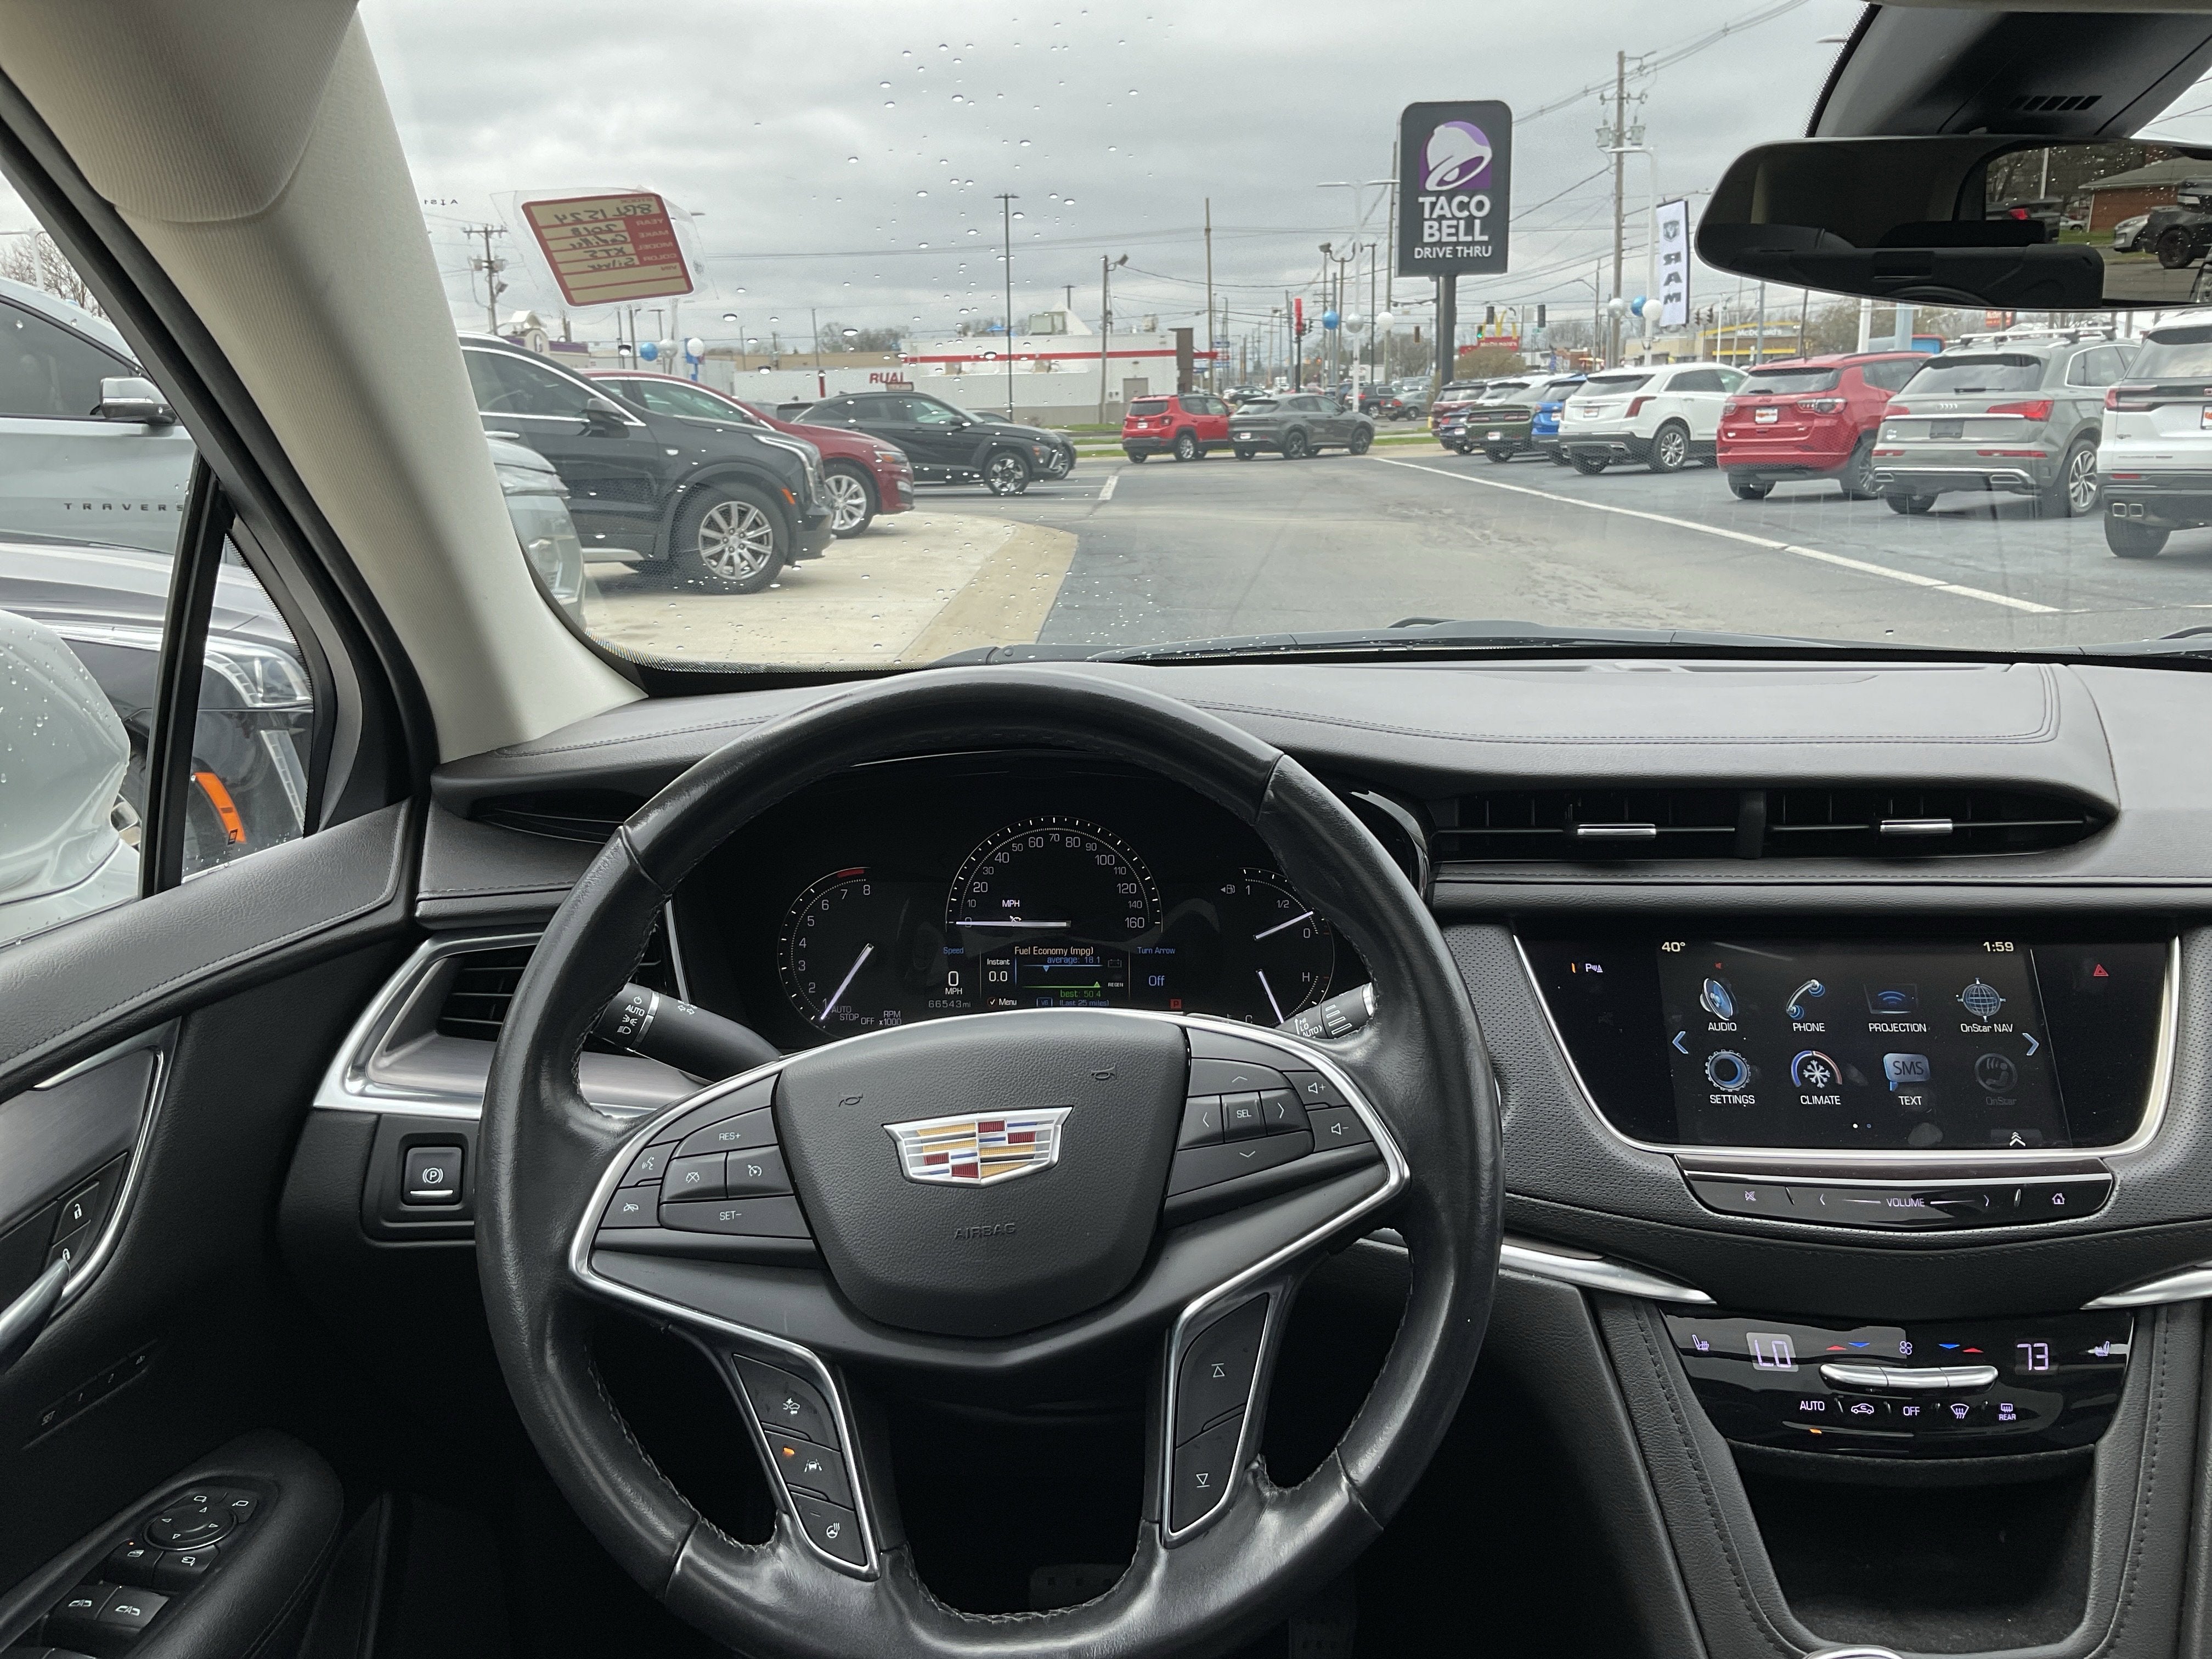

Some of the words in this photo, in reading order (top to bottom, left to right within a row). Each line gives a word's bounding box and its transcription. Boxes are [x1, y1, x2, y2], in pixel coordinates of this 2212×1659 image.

[1418, 195, 1491, 219] TACO
[1423, 219, 1489, 243] BELL
[1414, 247, 1453, 259] DRIVE
[1455, 245, 1492, 258] THRU
[1029, 837, 1043, 848] 60
[1049, 833, 1060, 842] 70
[1065, 837, 1080, 848] 80
[1012, 843, 1023, 851] 50
[1086, 843, 1097, 851] 90
[994, 853, 1009, 863] 40
[1094, 855, 1115, 865] 100
[983, 867, 994, 875] 30
[1114, 866, 1126, 875] 110
[863, 884, 871, 895] 8
[973, 882, 988, 893] 20
[1116, 883, 1137, 894] 120
[1245, 885, 1250, 895] 1
[840, 889, 848, 899] 7
[822, 900, 829, 910] 6
[1128, 900, 1142, 909] 140
[1277, 900, 1289, 909] 1/2
[807, 916, 815, 927] 5
[1125, 917, 1144, 928] 160
[1303, 928, 1311, 939] 0
[799, 938, 806, 948] 4
[1661, 941, 1686, 952] 40°
[1983, 941, 2014, 952] 1:59
[943, 946, 964, 955] Speed
[1014, 946, 1030, 955] Fuel
[1033, 946, 1068, 956] Economy
[1070, 946, 1093, 956] (mpg)
[798, 961, 805, 971] 3
[948, 970, 959, 986] 0
[989, 970, 1008, 981] 0.0
[1148, 975, 1165, 986] Off
[1302, 972, 1310, 982] H
[808, 983, 816, 993] 2
[625, 1004, 645, 1017] AUTO
[1300, 1023, 1309, 1032] LO
[1302, 1026, 1319, 1037] AUTO
[1708, 1022, 1737, 1032] AUDIO
[1792, 1023, 1826, 1032] PHONE
[1868, 1023, 1927, 1032] PROJECTION
[1960, 1023, 1992, 1032] OnStar
[1994, 1023, 2013, 1032] NAV
[1893, 1060, 1924, 1075] SMS
[1709, 1094, 1756, 1104] SETTINGS
[1800, 1095, 1841, 1105] CLIMATE
[1898, 1096, 1922, 1105] TEXT
[1985, 1097, 2017, 1106] OnStar
[1236, 1109, 1252, 1118] SEL
[719, 1132, 741, 1141] RES+
[1886, 1198, 1925, 1207] VOLUME
[955, 1223, 1015, 1239] AIRBAG
[2017, 1342, 2049, 1371] 73
[1799, 1401, 1825, 1411] AUTO
[1903, 1406, 1920, 1416] OFF
